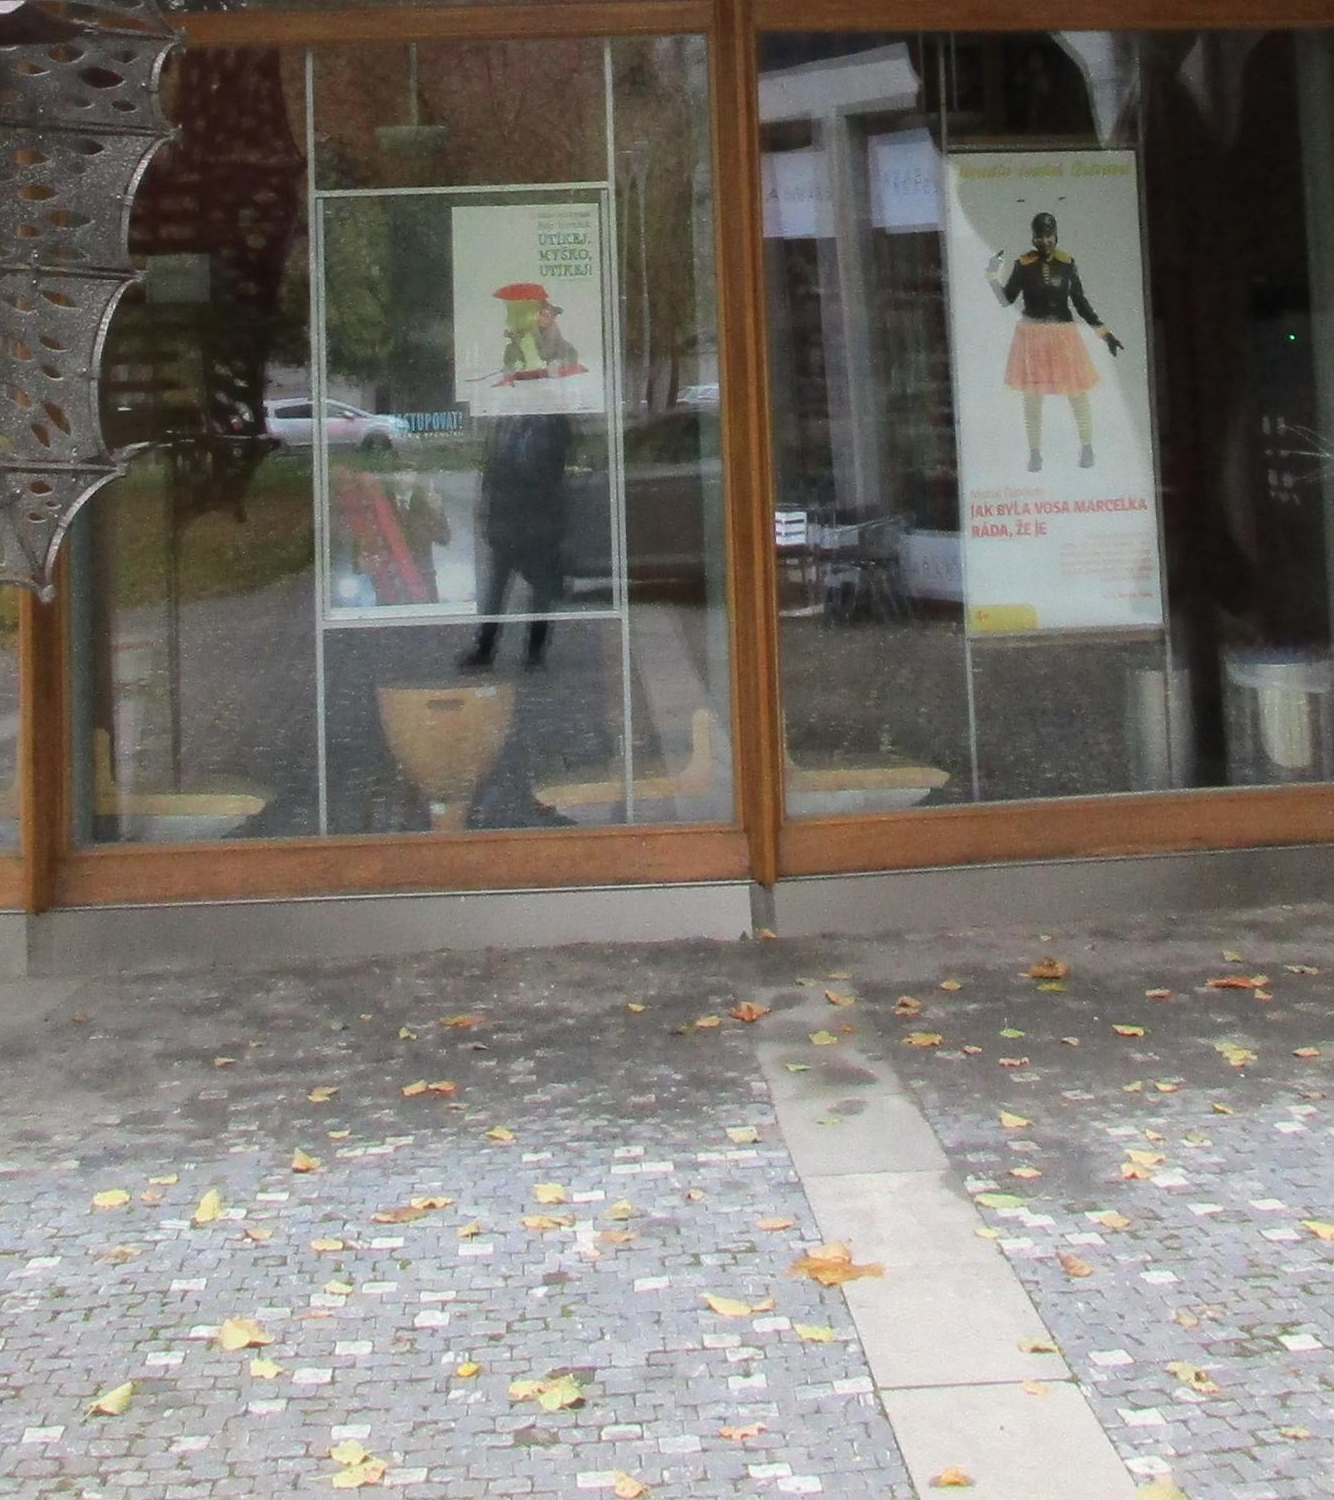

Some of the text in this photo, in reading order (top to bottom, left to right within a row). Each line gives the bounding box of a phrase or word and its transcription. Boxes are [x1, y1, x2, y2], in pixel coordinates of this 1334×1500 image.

[970, 496, 1148, 520] JAK BYLA VOSA MARCELKA
[971, 518, 1048, 539] RÁDA, ŽE JE
